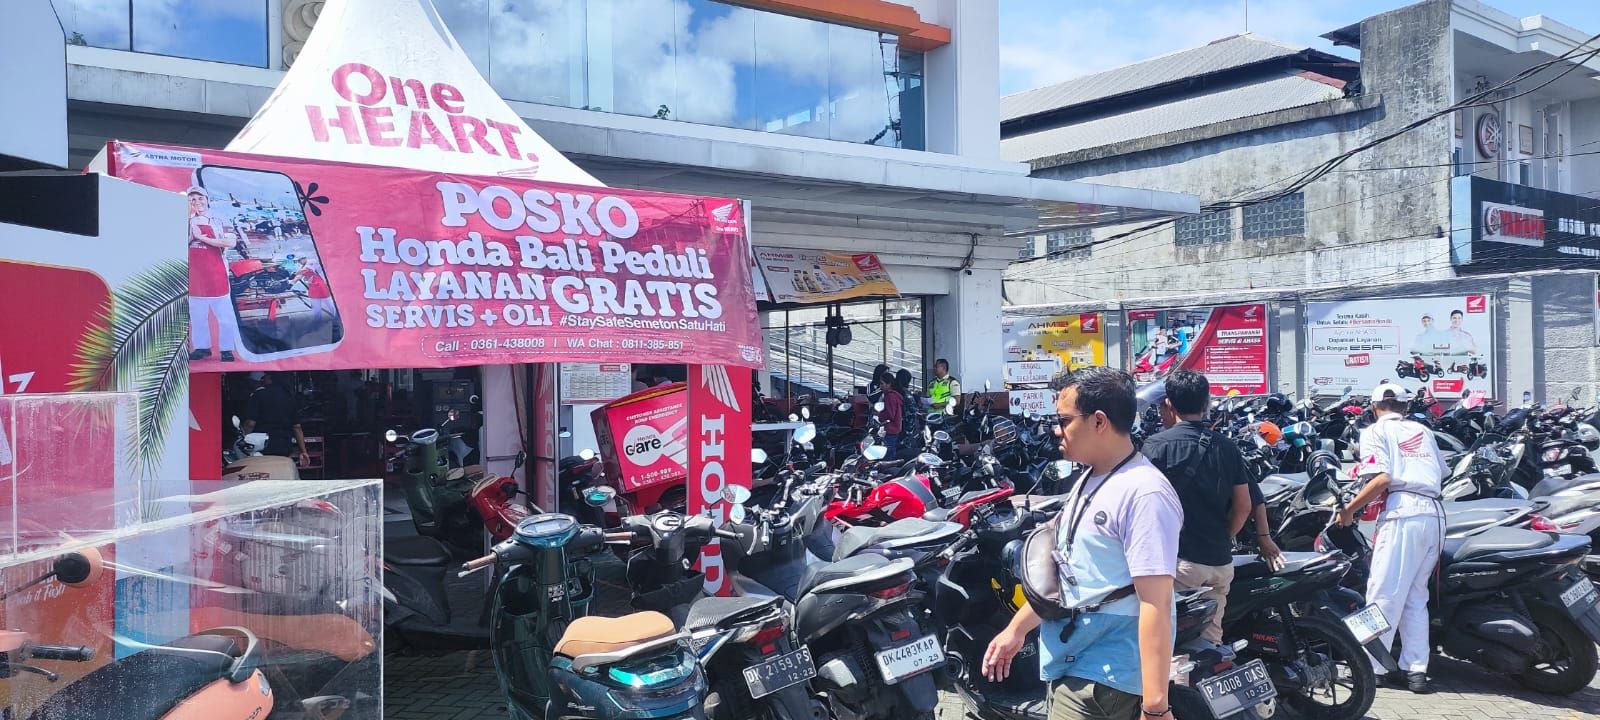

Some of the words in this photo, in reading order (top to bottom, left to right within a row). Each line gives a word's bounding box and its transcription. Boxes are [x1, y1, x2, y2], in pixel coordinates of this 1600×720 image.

[332, 63, 464, 113] One
[305, 105, 539, 162] HEART.
[436, 181, 639, 239] POSKO
[356, 226, 513, 266] Honda
[515, 235, 596, 271] Bali
[598, 241, 714, 279] Peduli
[361, 269, 547, 300] LAYANAN
[552, 275, 722, 319] GRATIS
[366, 304, 475, 328] SERVIS
[480, 309, 498, 326] +
[502, 304, 552, 327] OLI
[560, 314, 726, 332] #StaySafeSemetonSatuHati
[435, 340, 459, 352] Call
[470, 338, 545, 350] 0361-438008
[567, 339, 584, 348] WA
[589, 339, 613, 349] Chat
[622, 339, 684, 350] 0811-385-851
[746, 667, 762, 683] DK
[766, 657, 793, 677] 2159
[796, 649, 810, 664] PS
[1206, 685, 1214, 699] P
[1217, 677, 1242, 695] 2008
